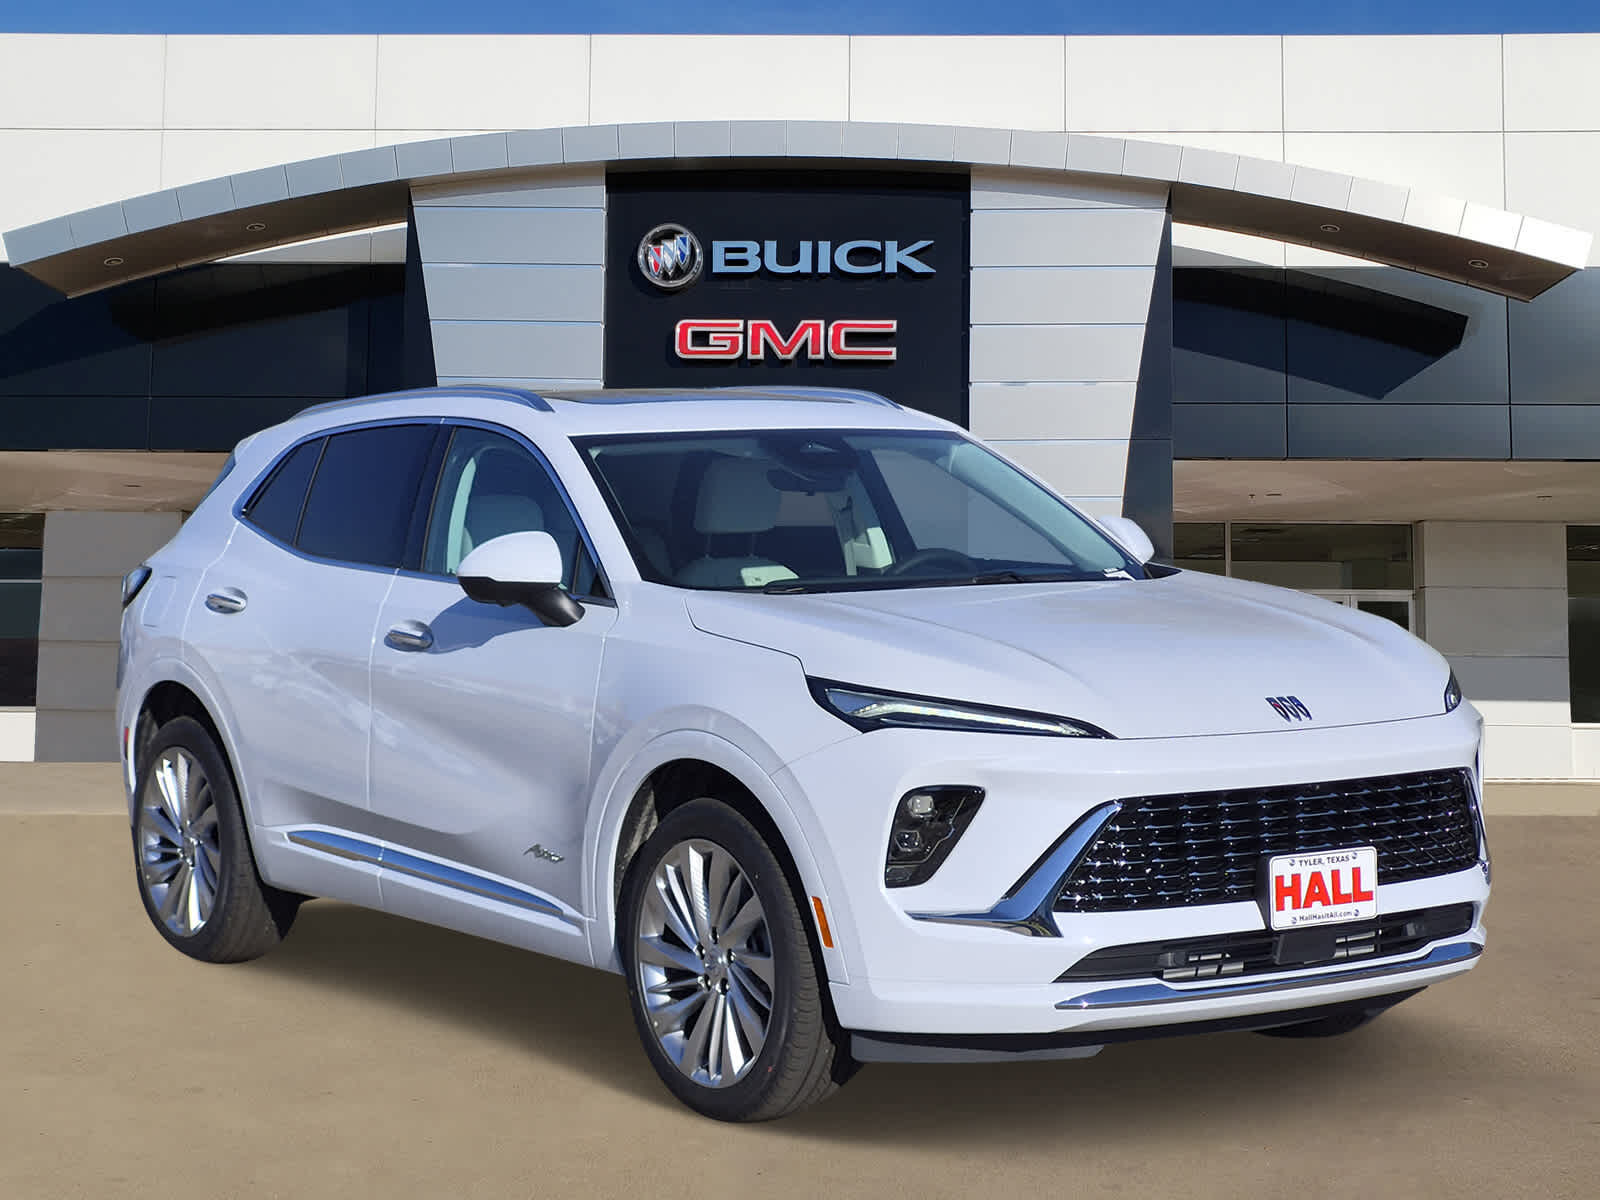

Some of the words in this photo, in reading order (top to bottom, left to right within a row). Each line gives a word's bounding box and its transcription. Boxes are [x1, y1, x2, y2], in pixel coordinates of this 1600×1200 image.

[712, 240, 937, 273] BUICK
[674, 319, 897, 360] GMC
[1327, 855, 1350, 864] TEXAS
[1275, 867, 1374, 912] HALL
